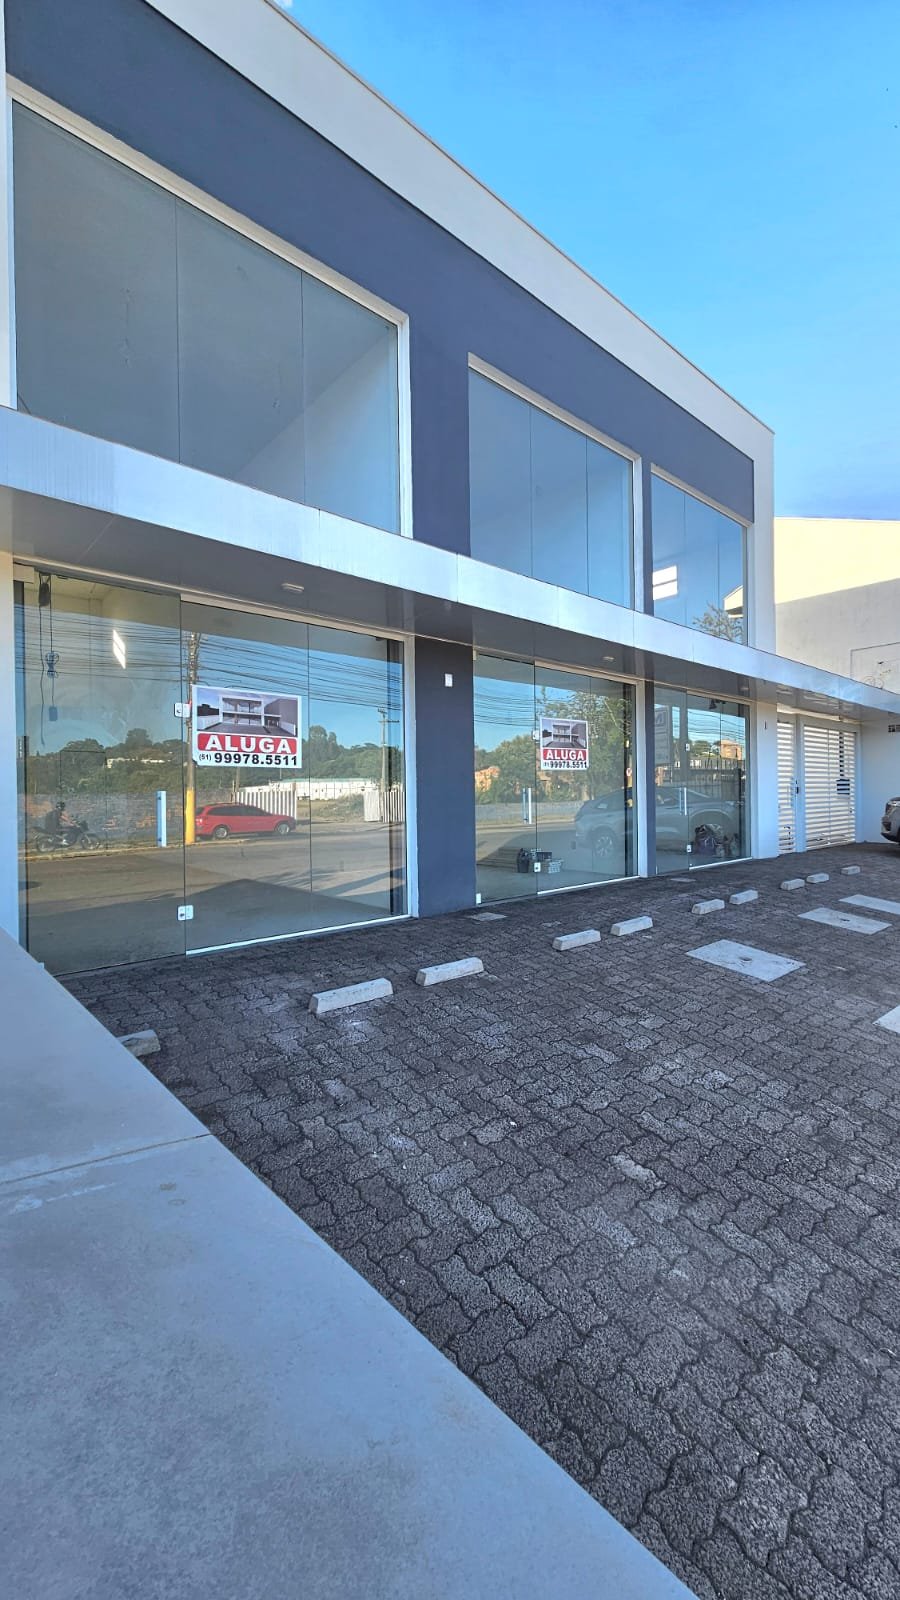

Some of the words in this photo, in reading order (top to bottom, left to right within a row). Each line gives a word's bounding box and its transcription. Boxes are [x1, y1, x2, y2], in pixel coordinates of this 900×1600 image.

[205, 735, 292, 753] ALUGA
[199, 753, 212, 761] (51)
[214, 752, 297, 766] 99978.5511
[546, 750, 584, 760] ALUGA
